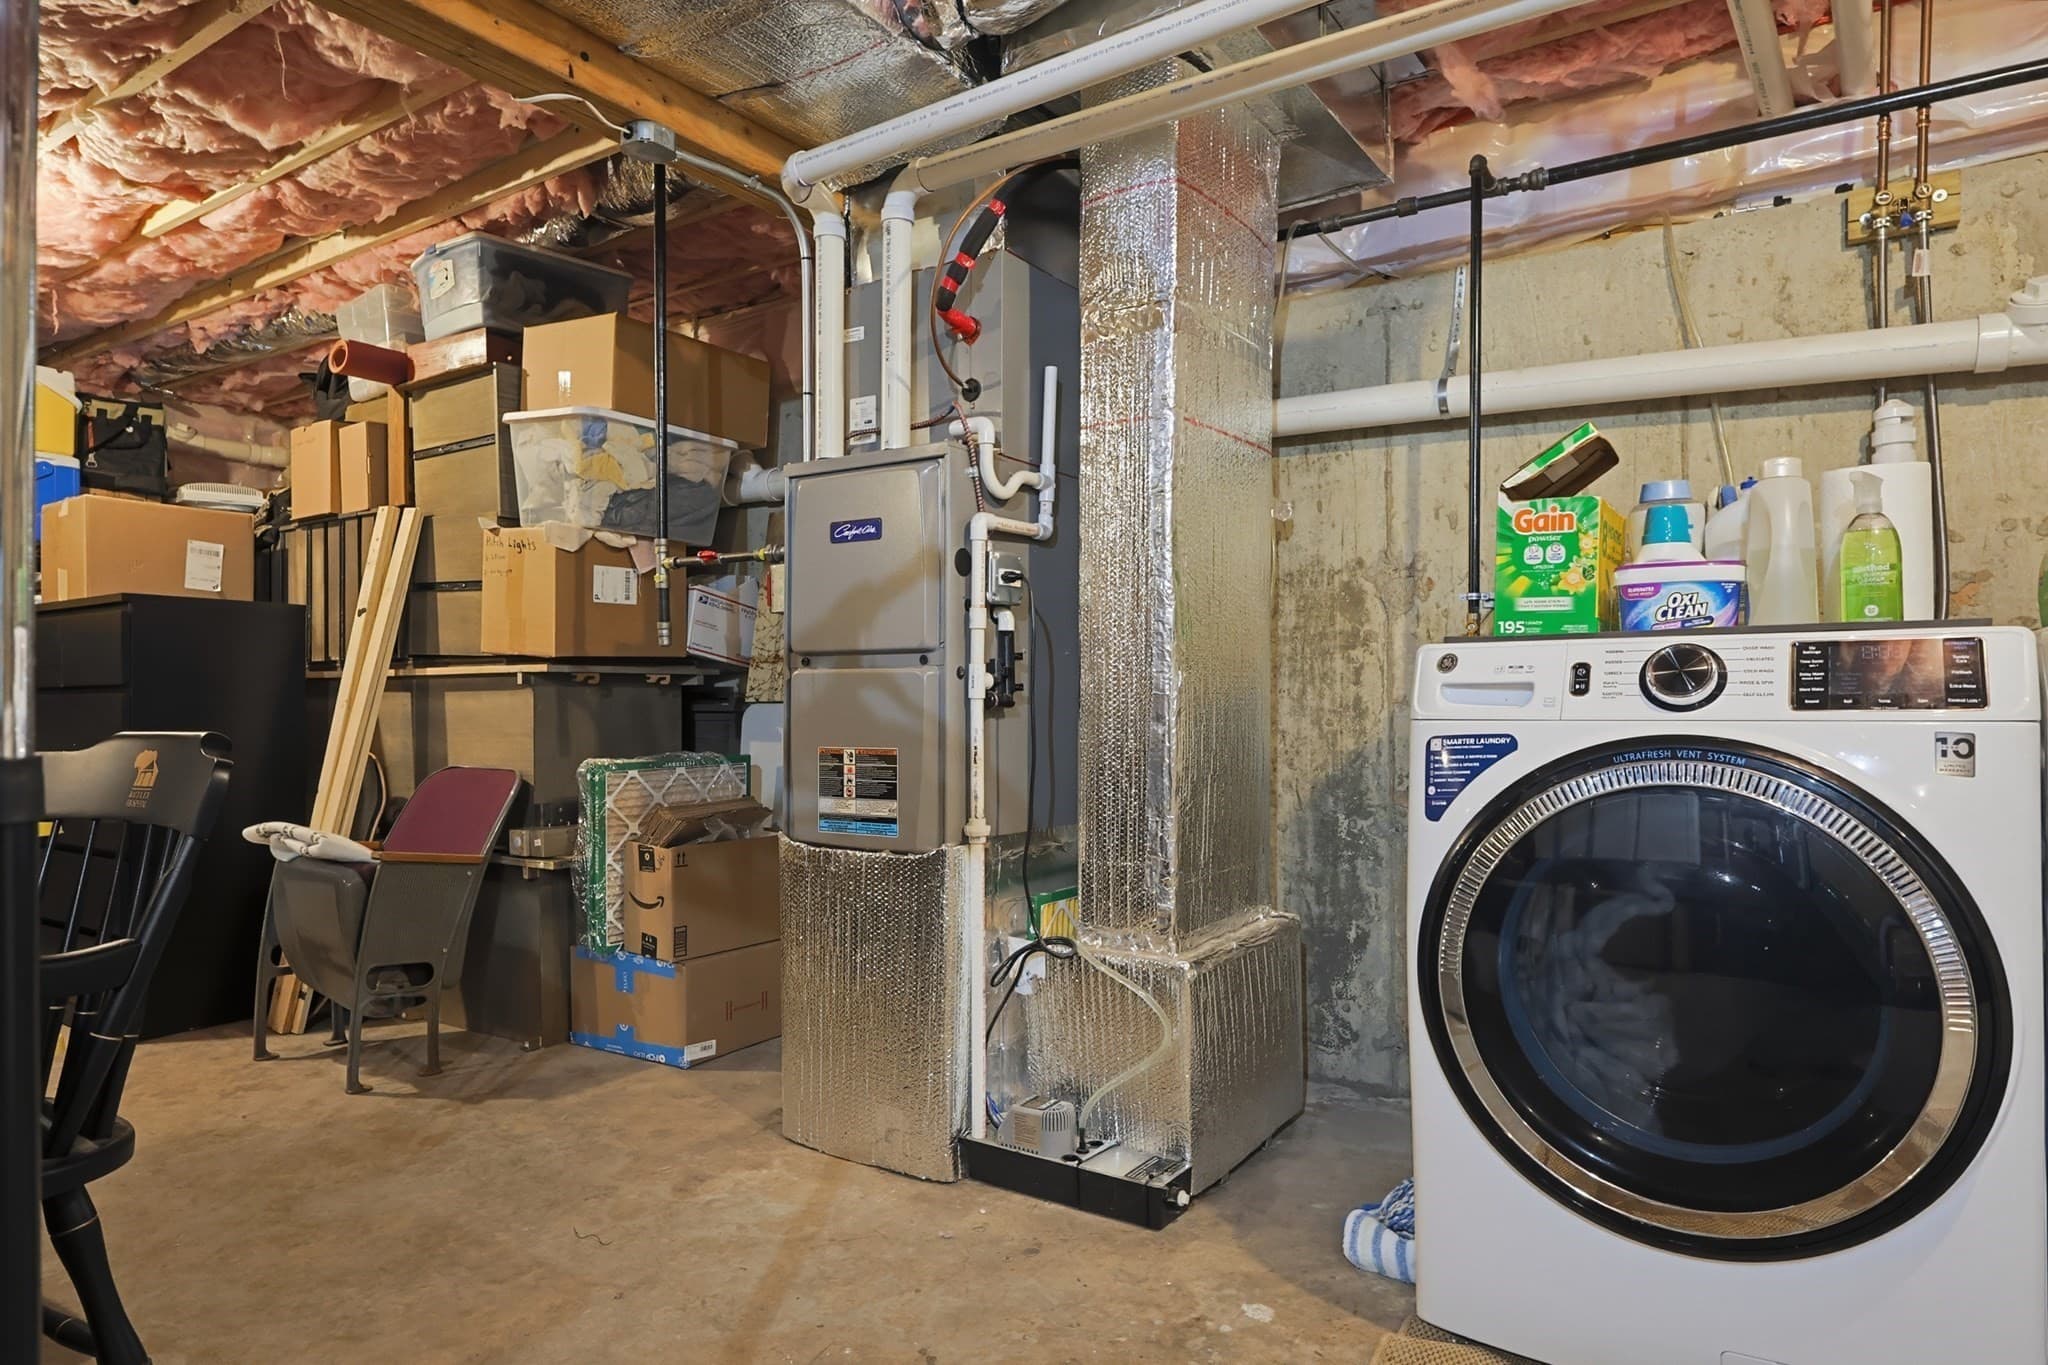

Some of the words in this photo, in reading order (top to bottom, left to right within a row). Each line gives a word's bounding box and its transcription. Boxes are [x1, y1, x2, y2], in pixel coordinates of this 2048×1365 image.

[1514, 505, 1575, 533] Gain
[508, 536, 537, 554] Lights
[1667, 592, 1698, 606] OXI
[1656, 603, 1708, 621] CLEAN
[1498, 621, 1525, 634] 195
[1613, 750, 1671, 763] ULTRAFRESH
[1676, 750, 1701, 759] VENT
[1707, 752, 1746, 766] SYSTEM
